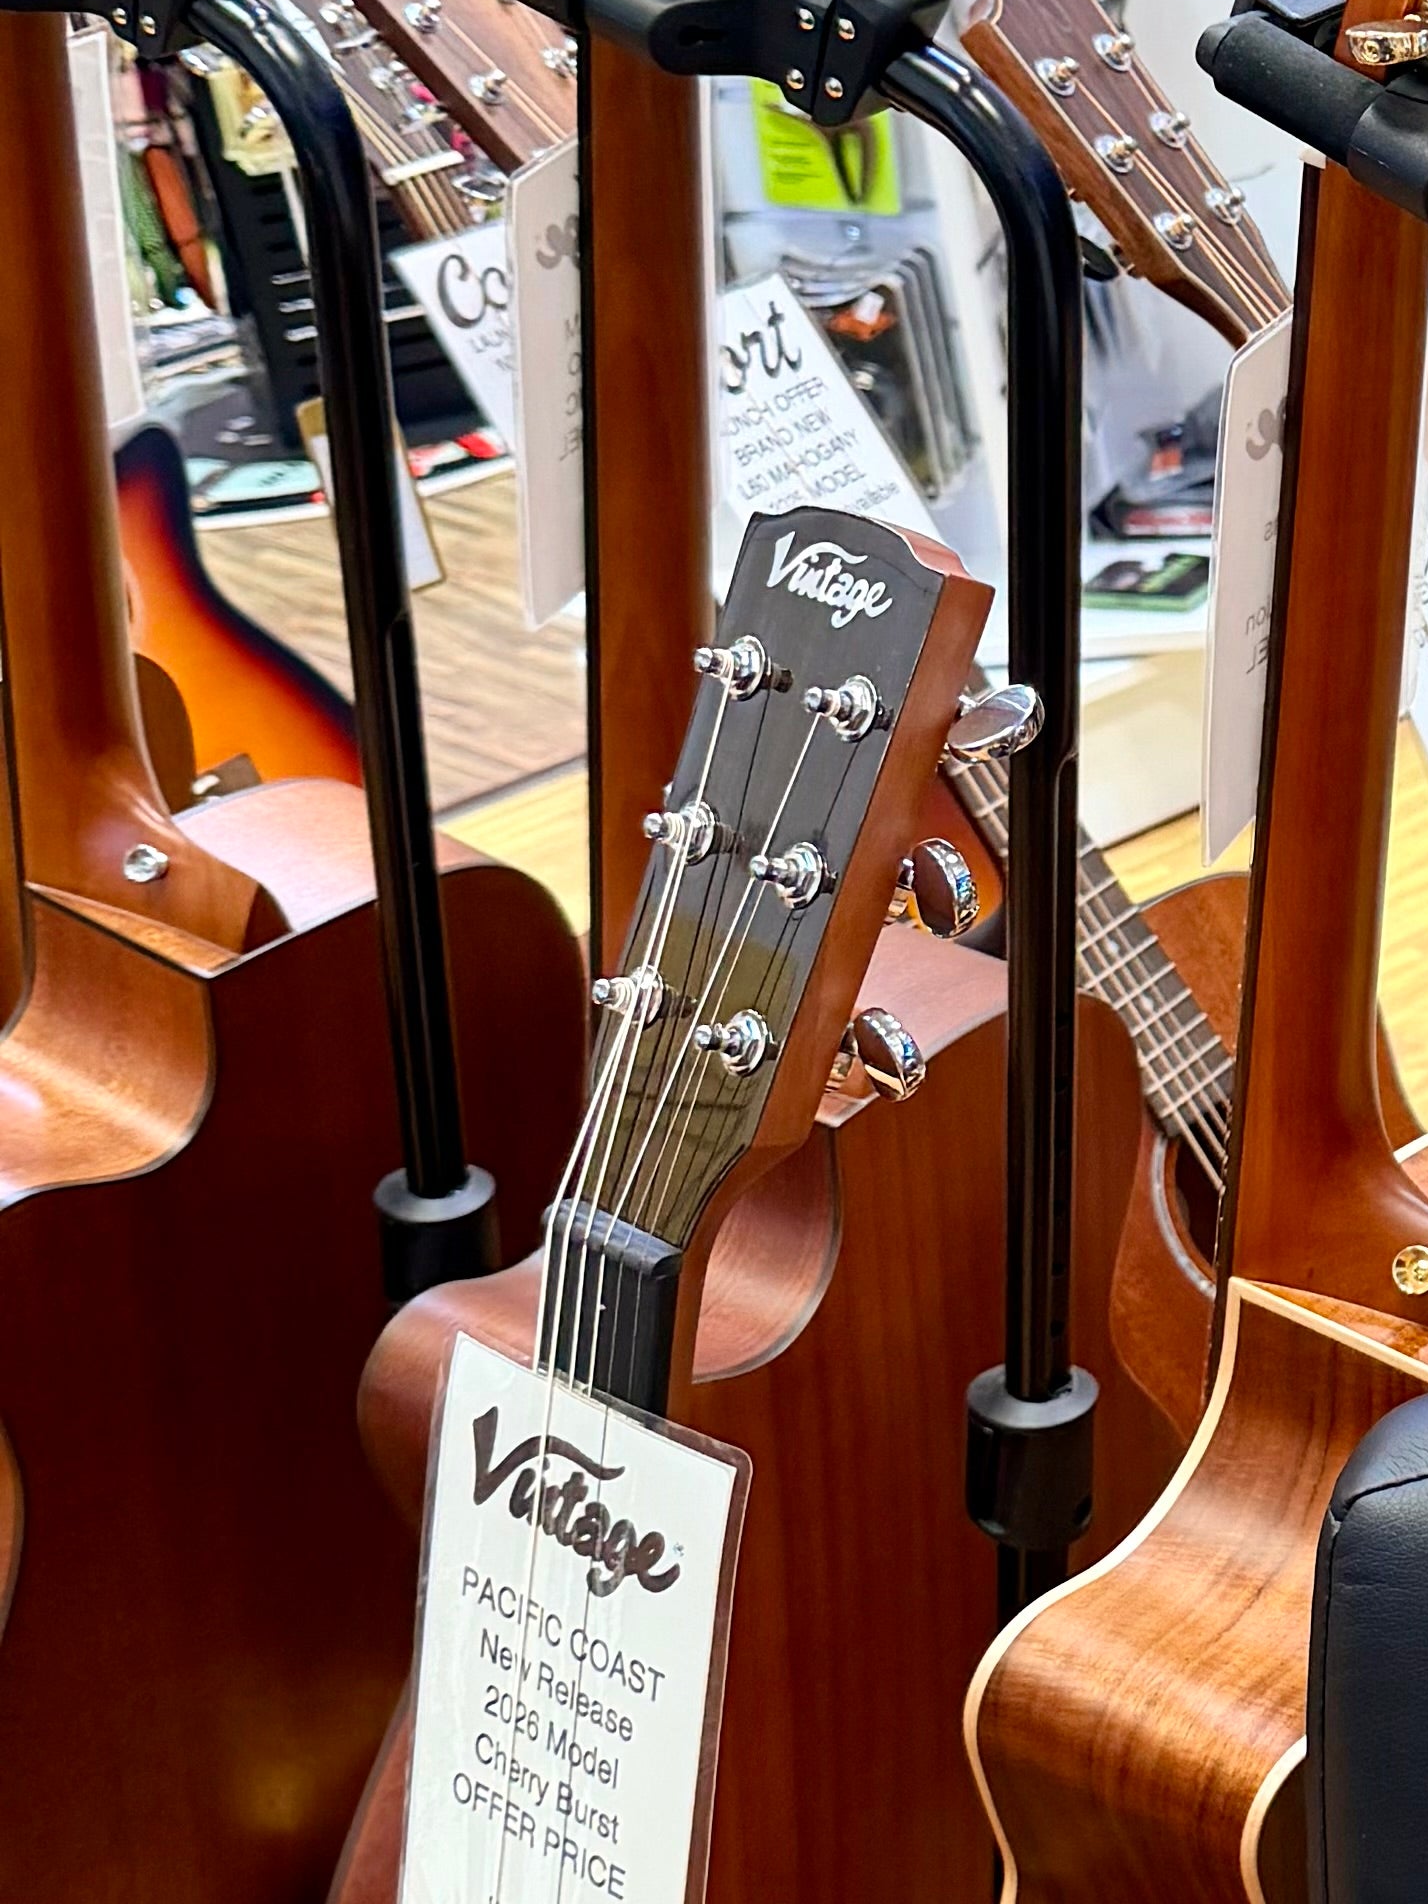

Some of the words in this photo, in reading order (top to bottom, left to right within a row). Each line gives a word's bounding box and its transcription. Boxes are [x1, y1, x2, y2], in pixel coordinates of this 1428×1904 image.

[721, 300, 802, 395] ort
[764, 529, 894, 629] Vintage
[472, 1405, 682, 1599] Vintage
[461, 1565, 564, 1651] PACIFIC
[569, 1627, 665, 1705] COAST
[480, 1627, 531, 1689] New
[535, 1658, 635, 1744] Release
[473, 1732, 549, 1813] Cherry
[556, 1774, 621, 1847] Burst
[483, 1684, 541, 1745] 2026
[545, 1720, 620, 1792] Model
[452, 1772, 537, 1850] OFFER
[542, 1829, 627, 1902] PRICE
